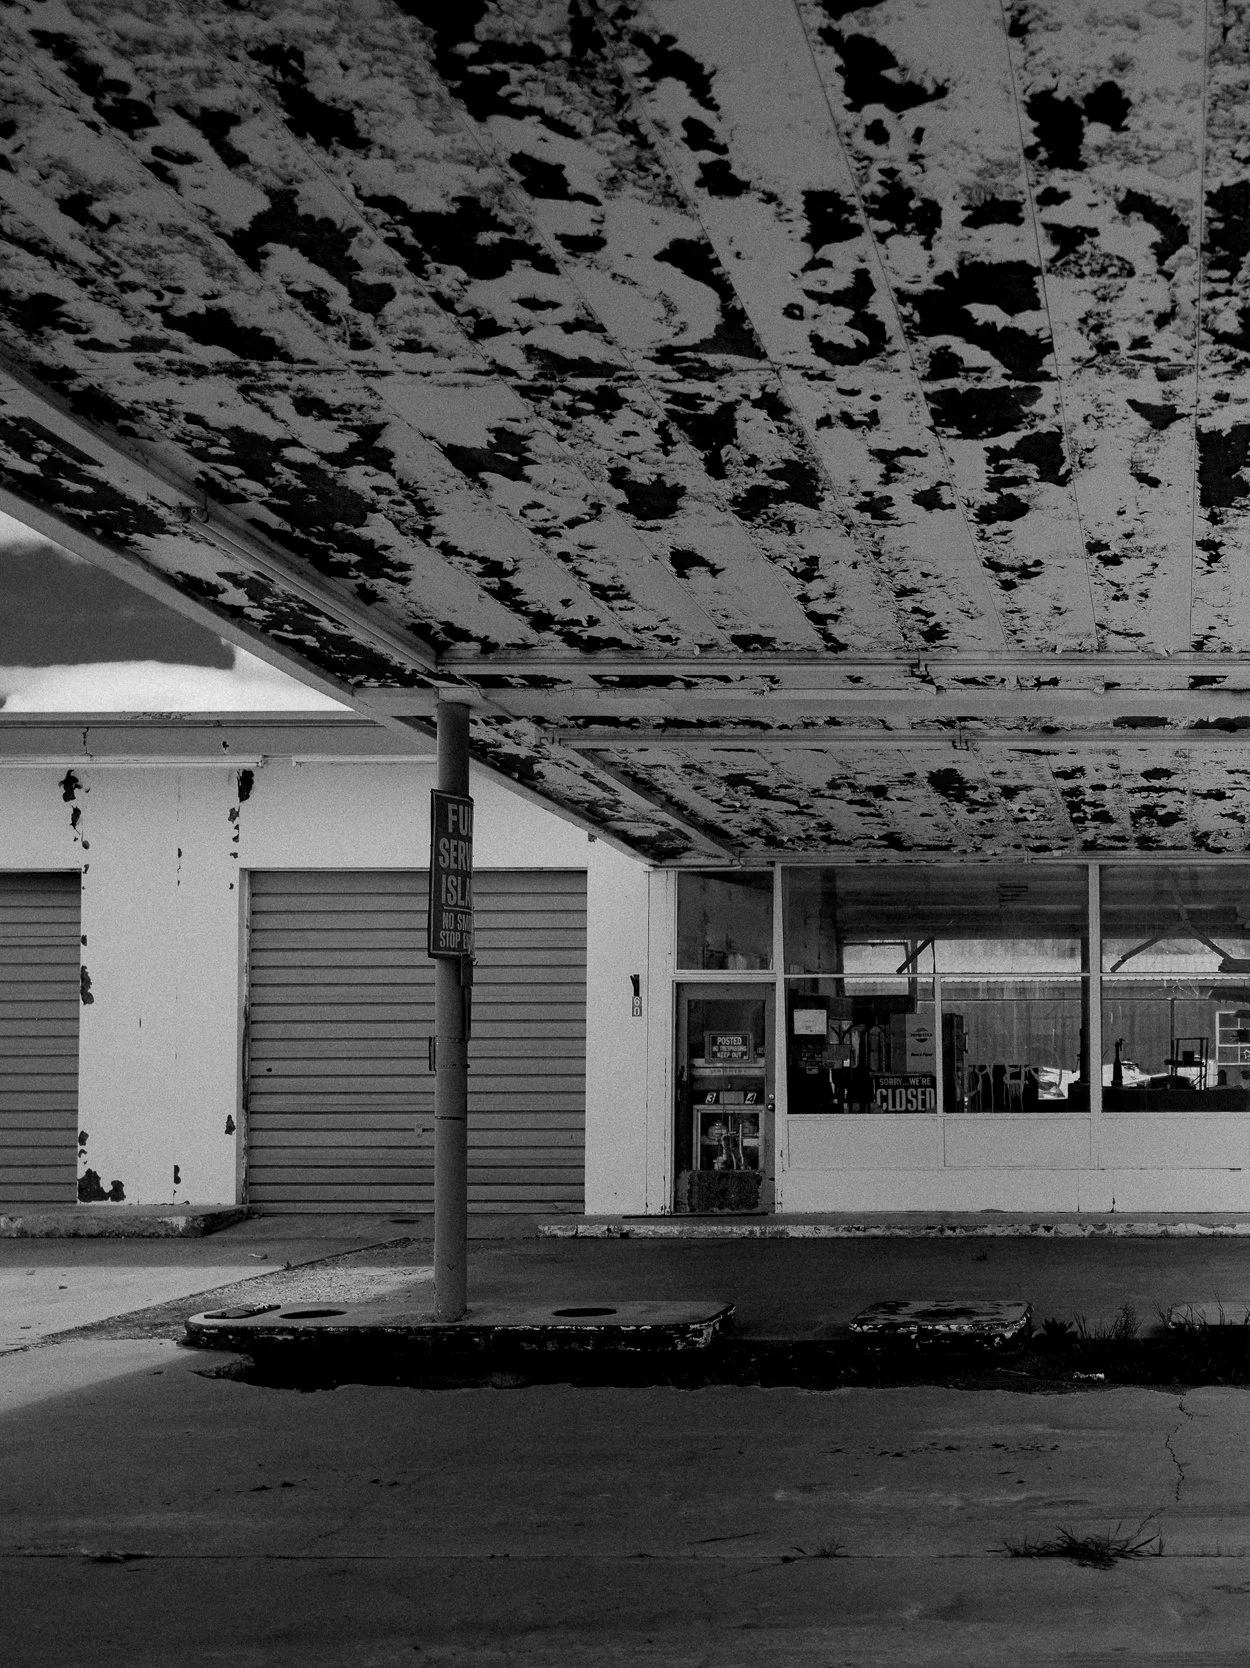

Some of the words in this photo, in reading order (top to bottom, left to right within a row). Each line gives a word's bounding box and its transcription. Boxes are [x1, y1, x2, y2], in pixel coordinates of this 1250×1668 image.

[442, 912, 455, 930] NO
[440, 930, 461, 949] STOP
[717, 1036, 743, 1046] POSTED
[876, 1088, 935, 1111] CLOSED
